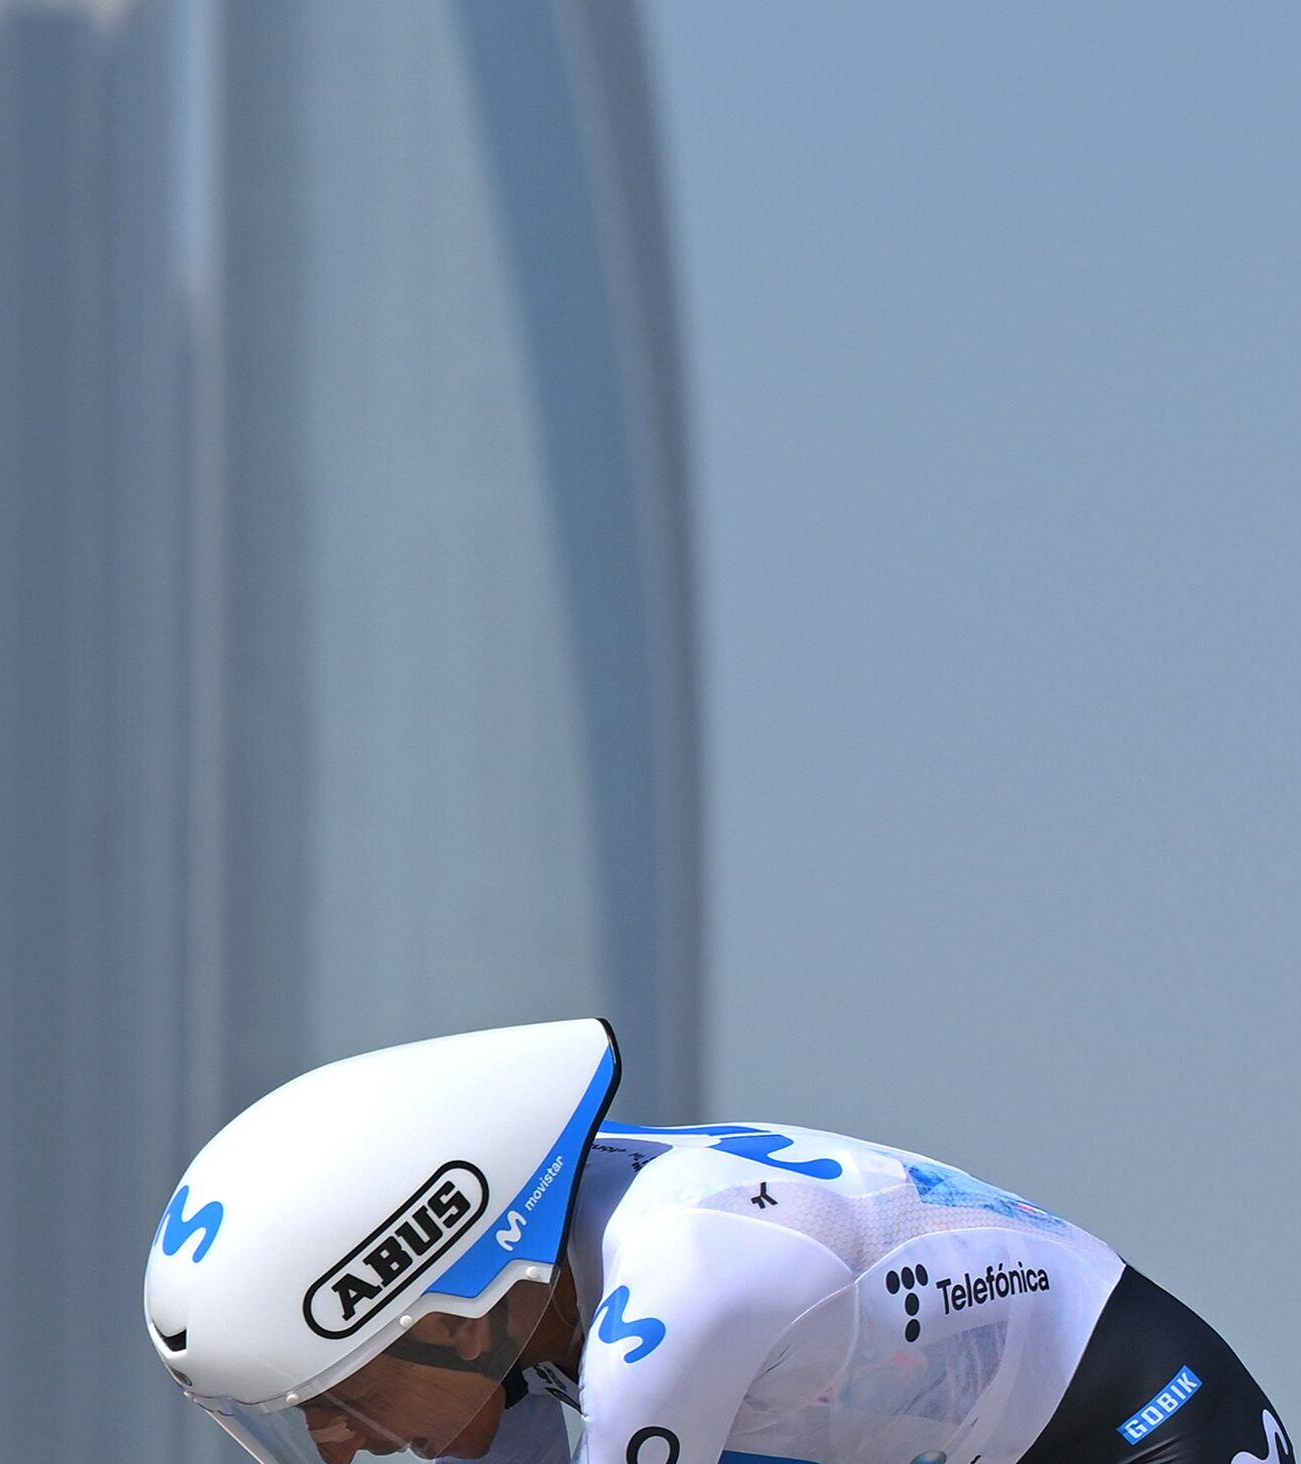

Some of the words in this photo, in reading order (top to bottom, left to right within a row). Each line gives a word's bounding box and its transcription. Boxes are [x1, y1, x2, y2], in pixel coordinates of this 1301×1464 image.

[525, 1156, 563, 1211] movistar
[331, 1181, 471, 1321] ABUS
[936, 1261, 1050, 1315] Telefónica
[1124, 1372, 1198, 1439] GOBIK
